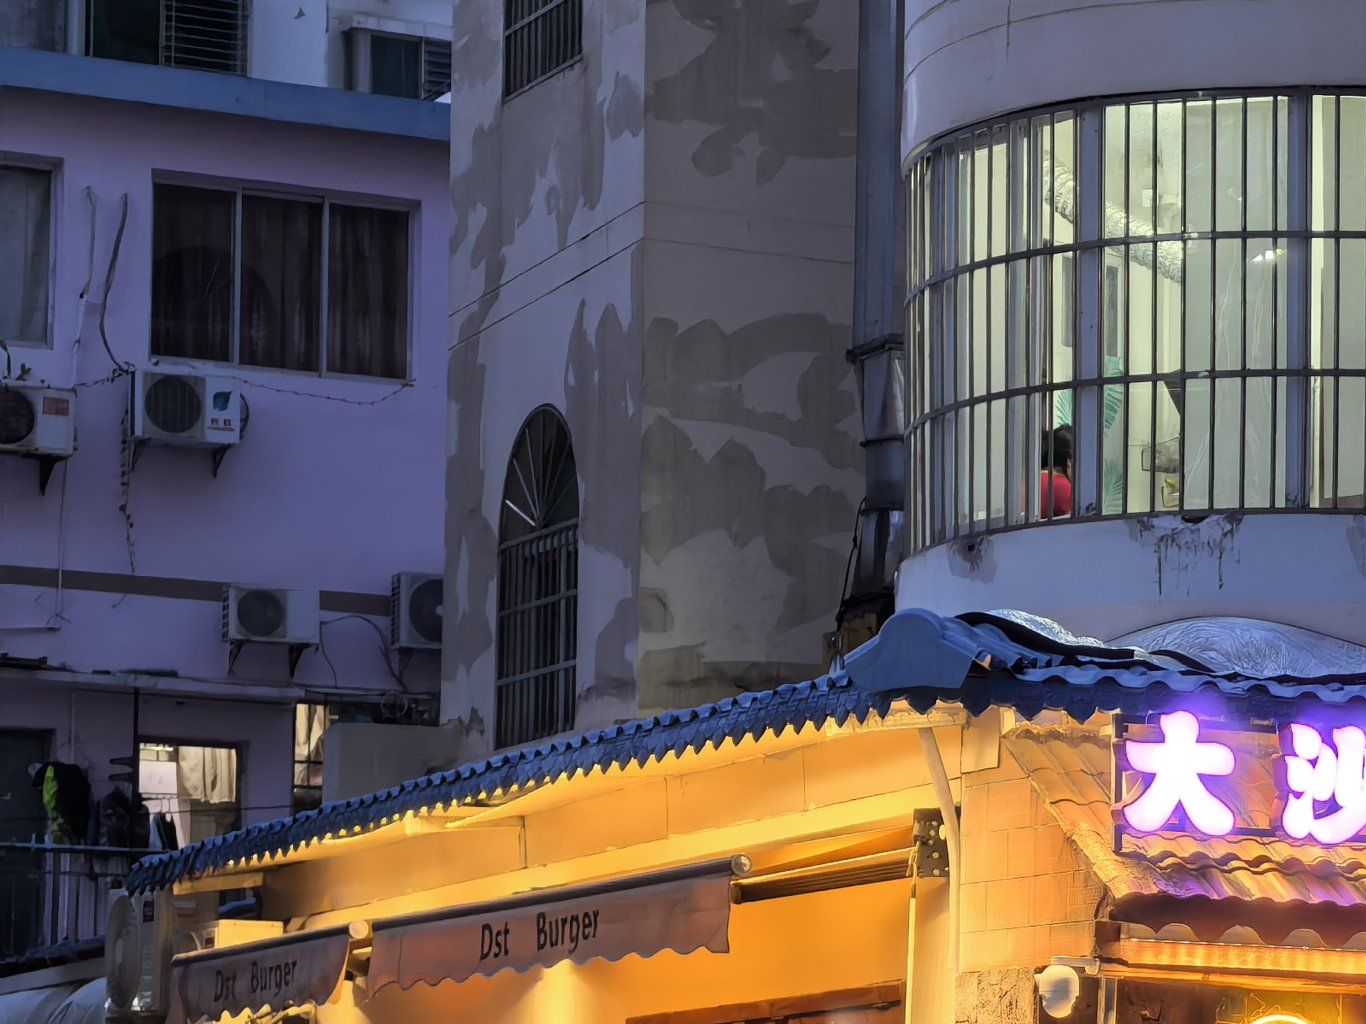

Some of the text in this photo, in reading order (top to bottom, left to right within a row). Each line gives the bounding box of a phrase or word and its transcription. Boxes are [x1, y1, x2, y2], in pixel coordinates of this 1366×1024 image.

[479, 909, 600, 962] Dst Burger
[250, 959, 298, 998] Burger
